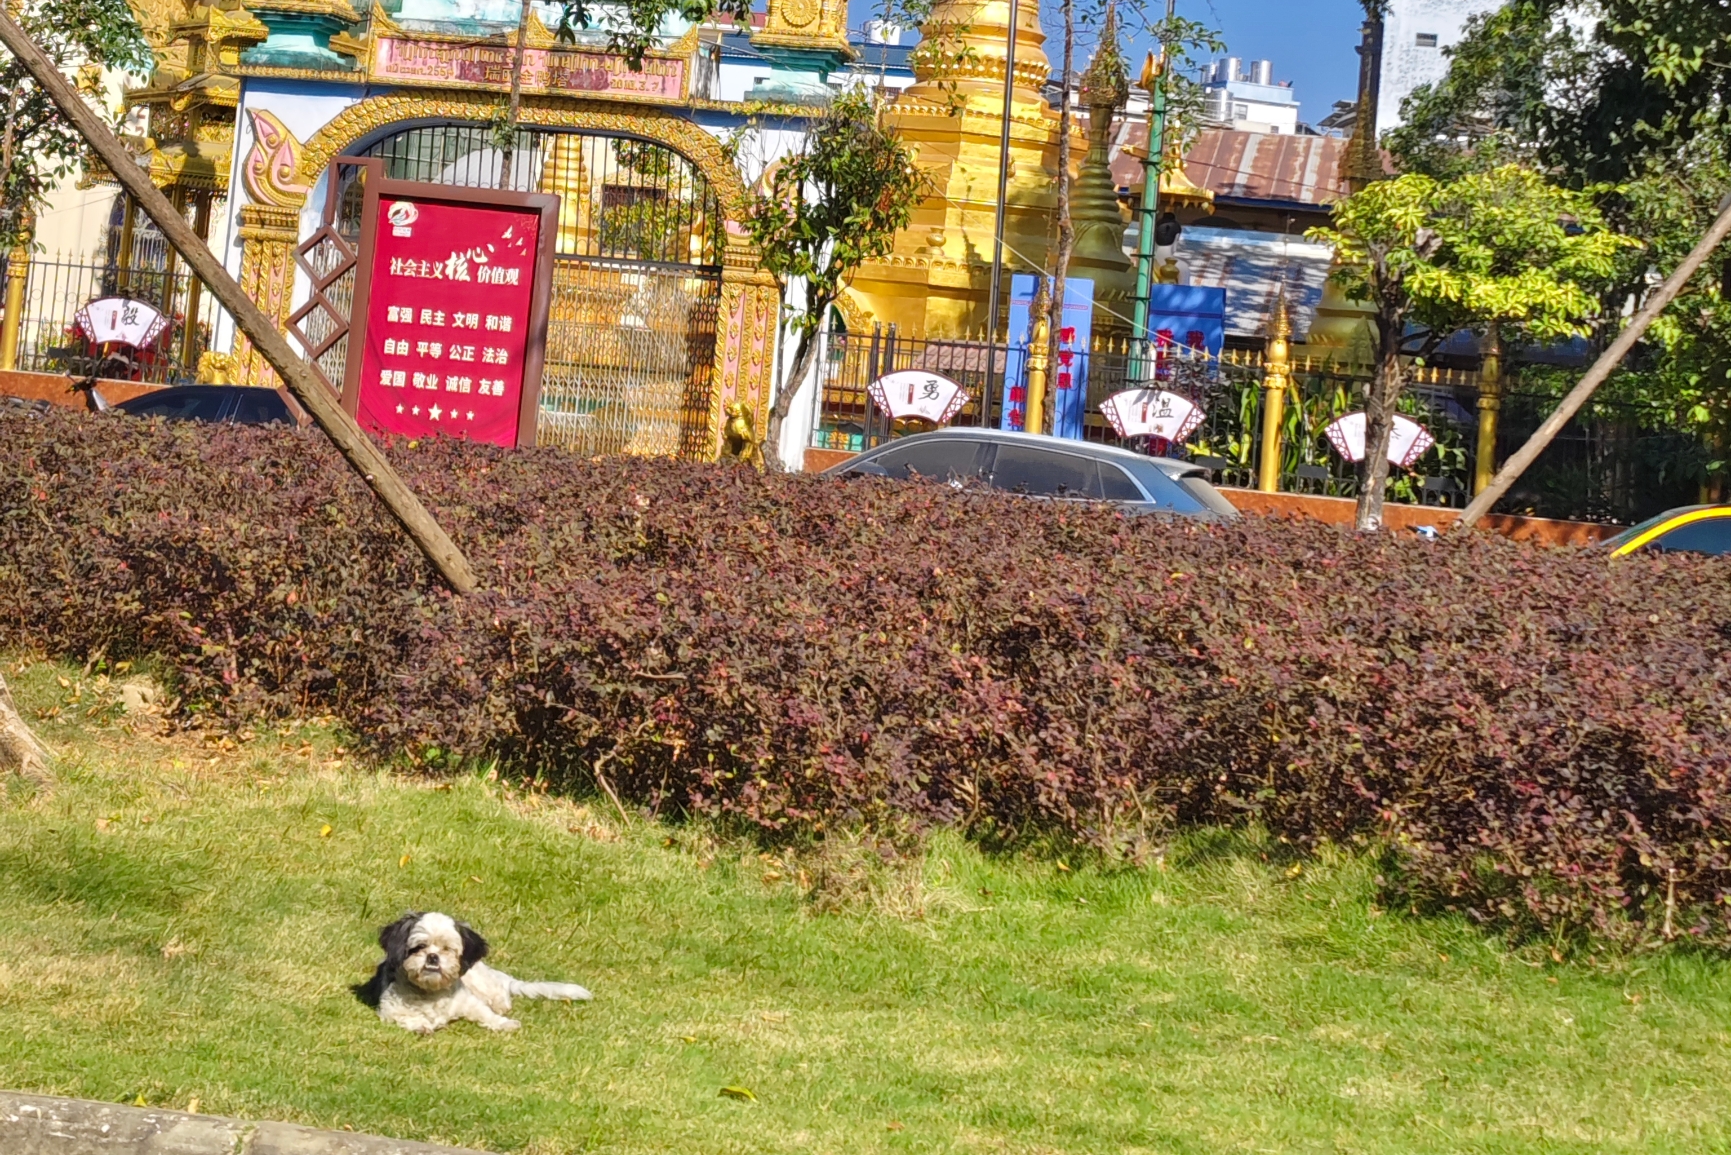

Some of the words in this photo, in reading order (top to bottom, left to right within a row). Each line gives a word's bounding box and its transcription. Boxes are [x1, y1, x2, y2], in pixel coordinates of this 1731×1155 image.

[389, 243, 520, 286] 社会主义核心价值观
[387, 305, 413, 324] 富强
[420, 308, 445, 326] 民主
[452, 311, 479, 330] 文明
[485, 314, 512, 332] 和谐
[384, 337, 409, 356] 自由
[416, 341, 442, 359] 平等
[449, 344, 475, 362] 公正
[482, 347, 509, 365] 法治
[379, 369, 406, 388] 爱国
[412, 372, 439, 390] 敬业
[445, 375, 472, 394] 诚信
[478, 378, 505, 396] 友善
[918, 379, 940, 401] 勇
